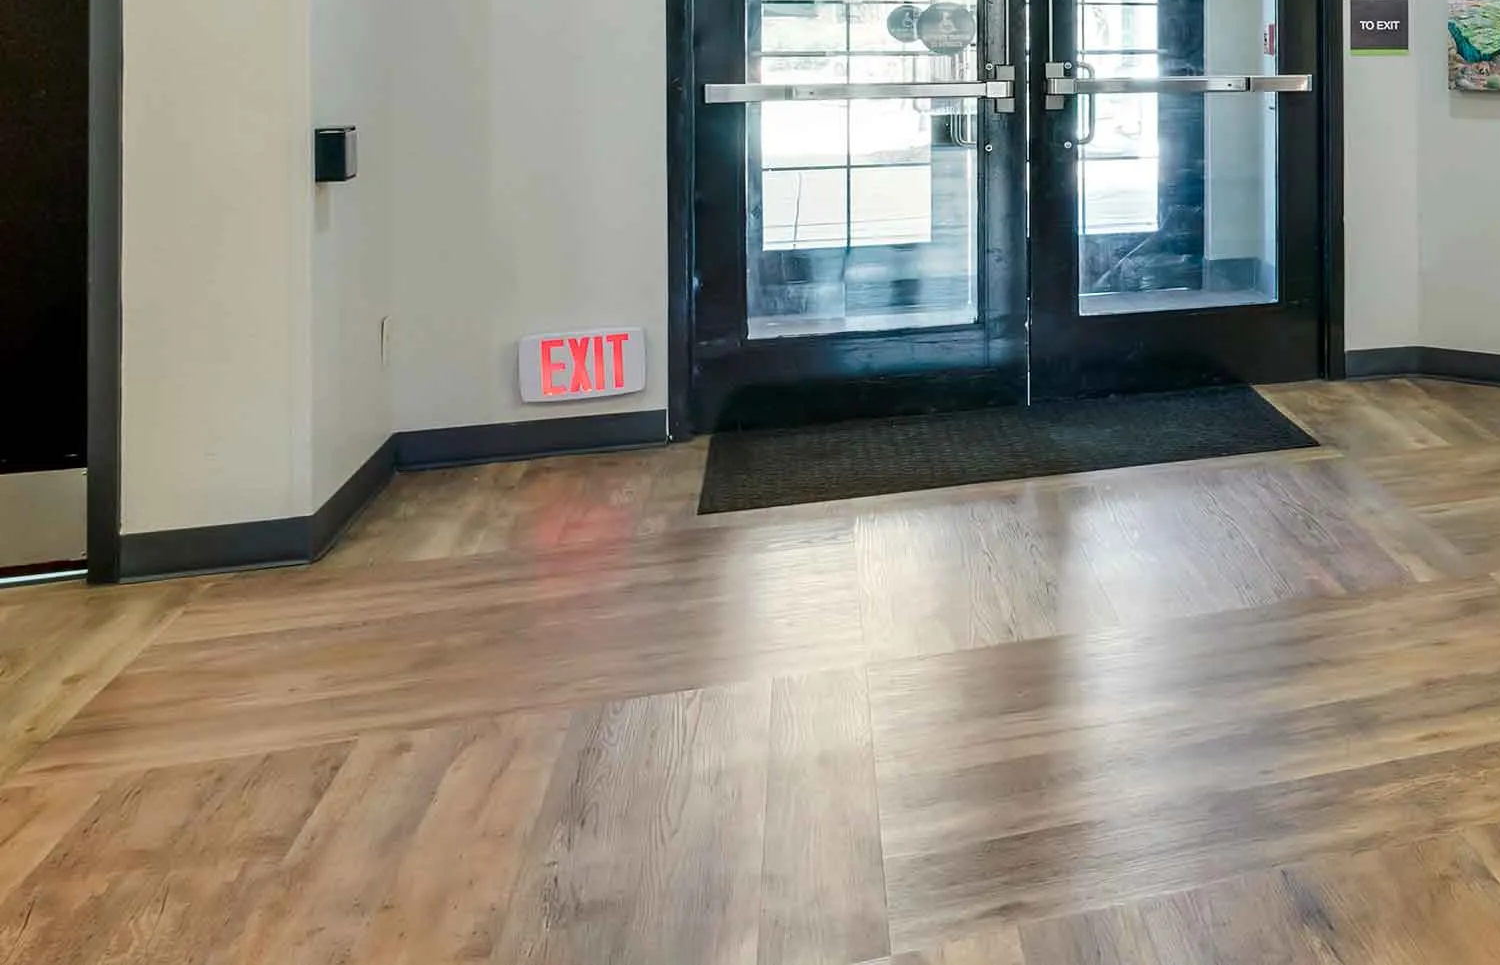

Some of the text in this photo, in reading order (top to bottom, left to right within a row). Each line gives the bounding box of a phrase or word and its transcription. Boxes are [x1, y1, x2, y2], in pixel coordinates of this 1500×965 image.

[1359, 20, 1400, 30] TO EXIT
[541, 333, 629, 396] EXIT
